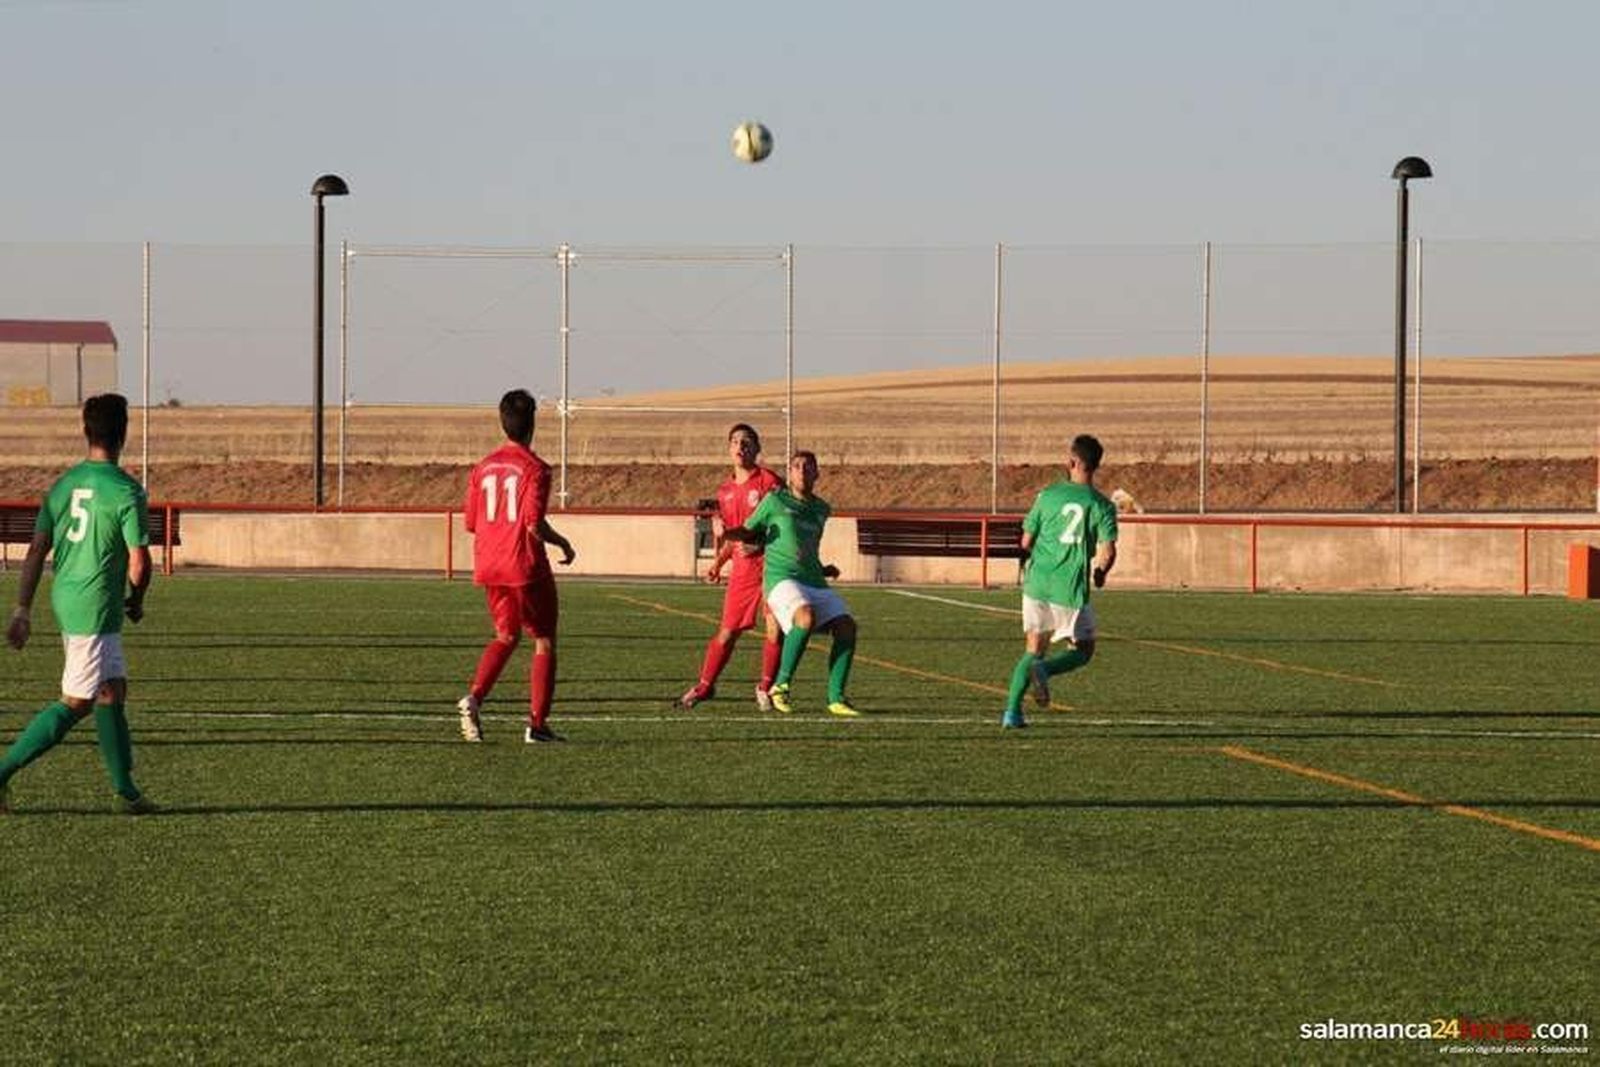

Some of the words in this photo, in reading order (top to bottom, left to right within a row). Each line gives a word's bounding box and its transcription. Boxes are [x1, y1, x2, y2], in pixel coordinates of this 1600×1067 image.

[66, 489, 93, 542] 5
[481, 474, 518, 523] 11
[1060, 503, 1084, 543] 2
